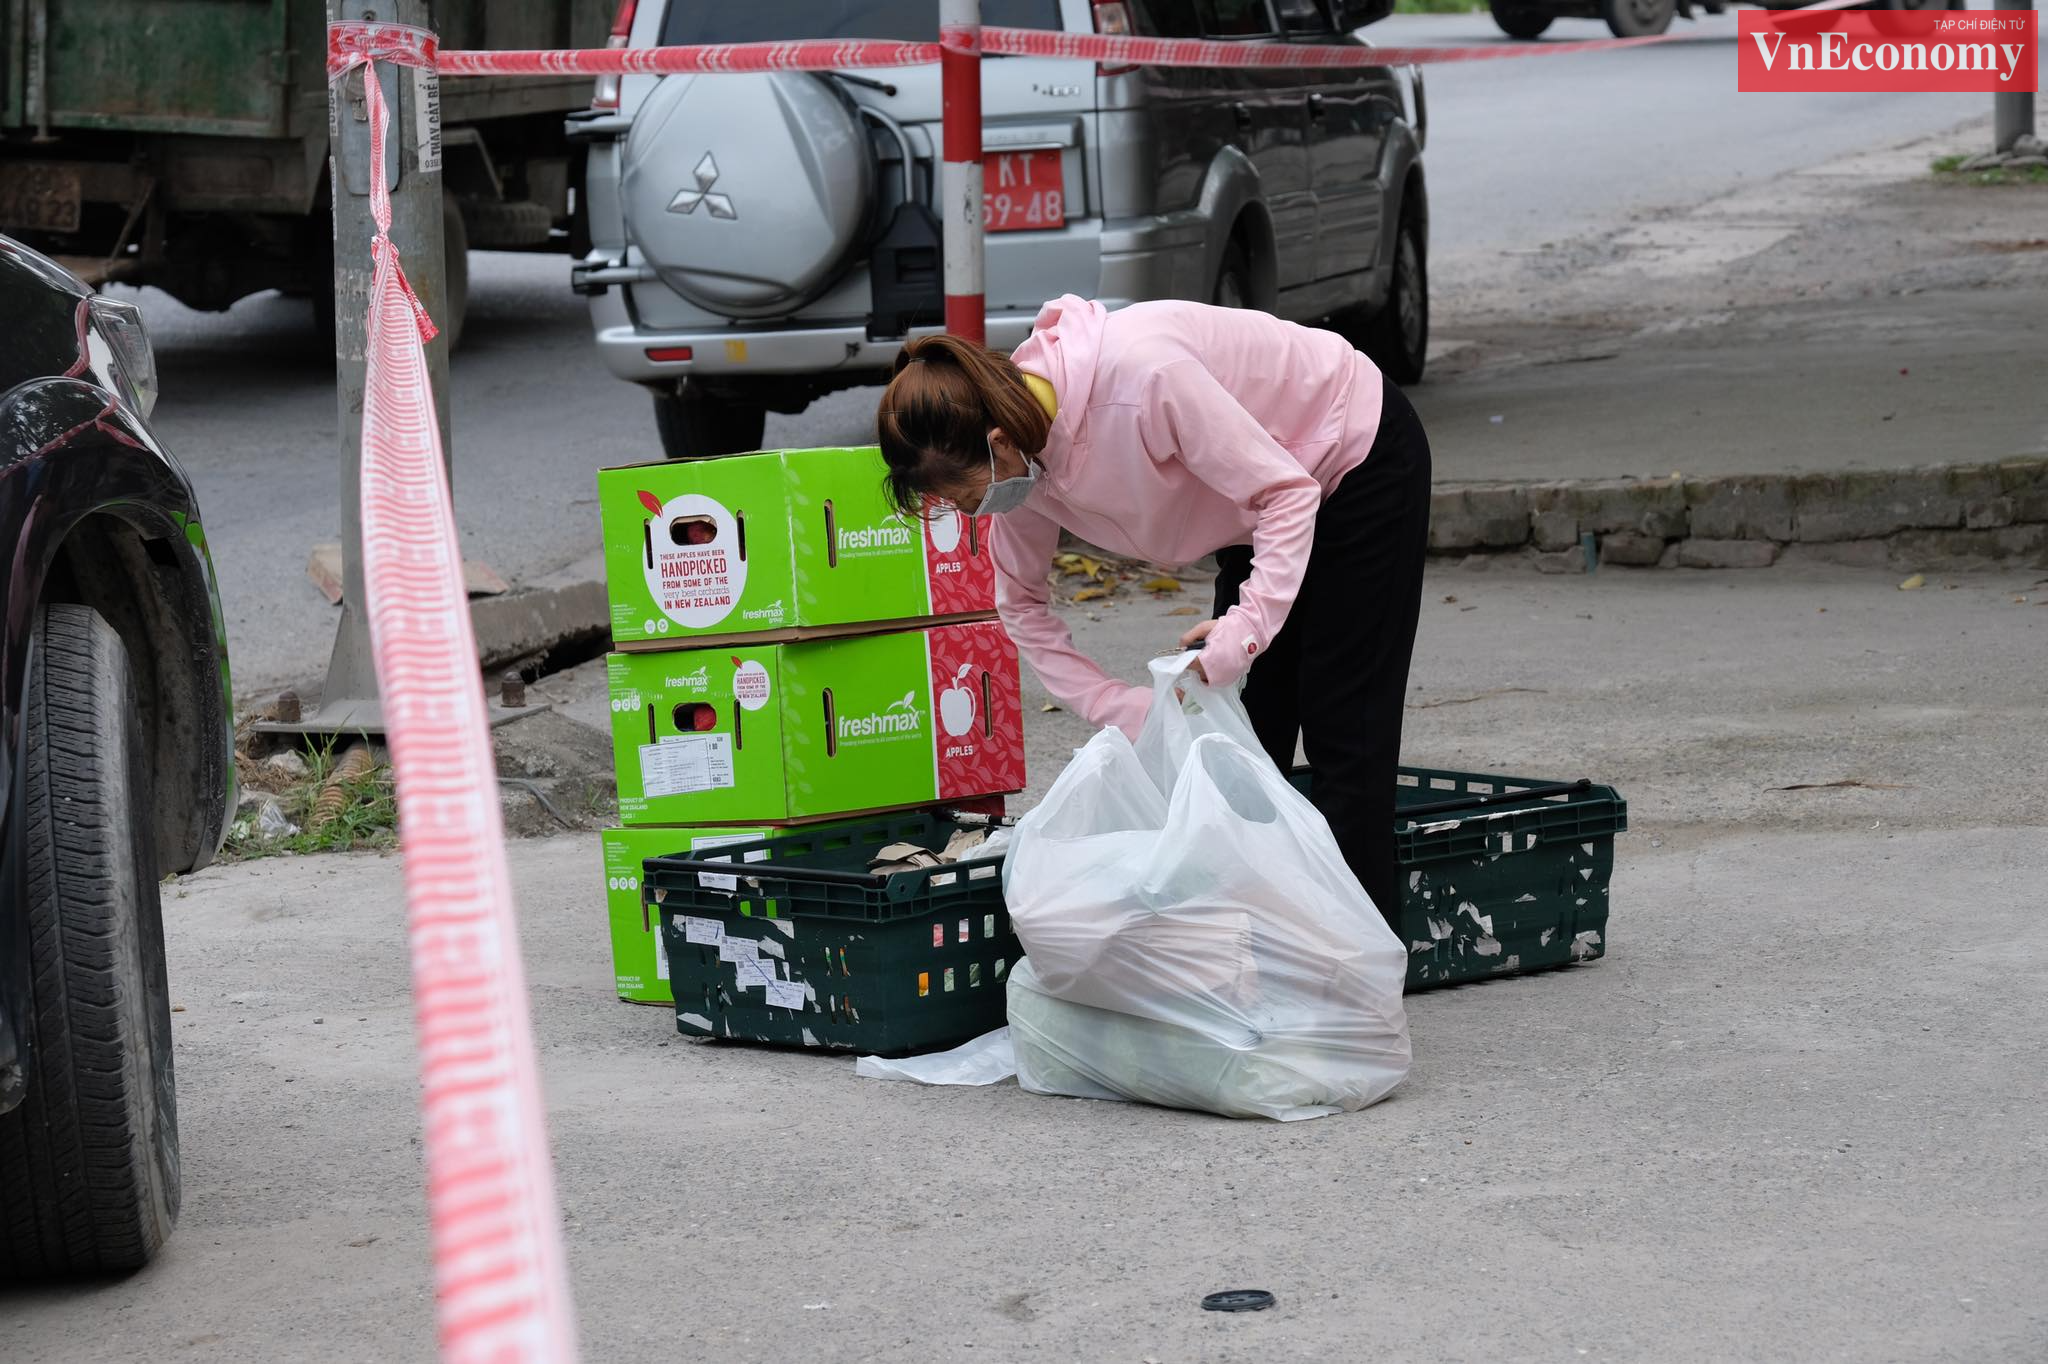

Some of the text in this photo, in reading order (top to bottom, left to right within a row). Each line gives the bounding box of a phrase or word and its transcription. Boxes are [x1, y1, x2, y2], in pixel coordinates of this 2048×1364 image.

[999, 153, 1034, 187] KT
[838, 525, 911, 549] freshmax
[677, 551, 696, 559] APPLES
[661, 558, 727, 578] HANDPICKED
[935, 562, 961, 574] APPLES
[662, 576, 729, 589] FROM SOME OF THE
[664, 591, 680, 599] very
[664, 595, 731, 610] IN NEW ZEALAND
[742, 608, 784, 620] freshmax
[665, 675, 708, 688] freshmax
[838, 711, 920, 738] freshmax
[945, 745, 974, 758] APPLES
